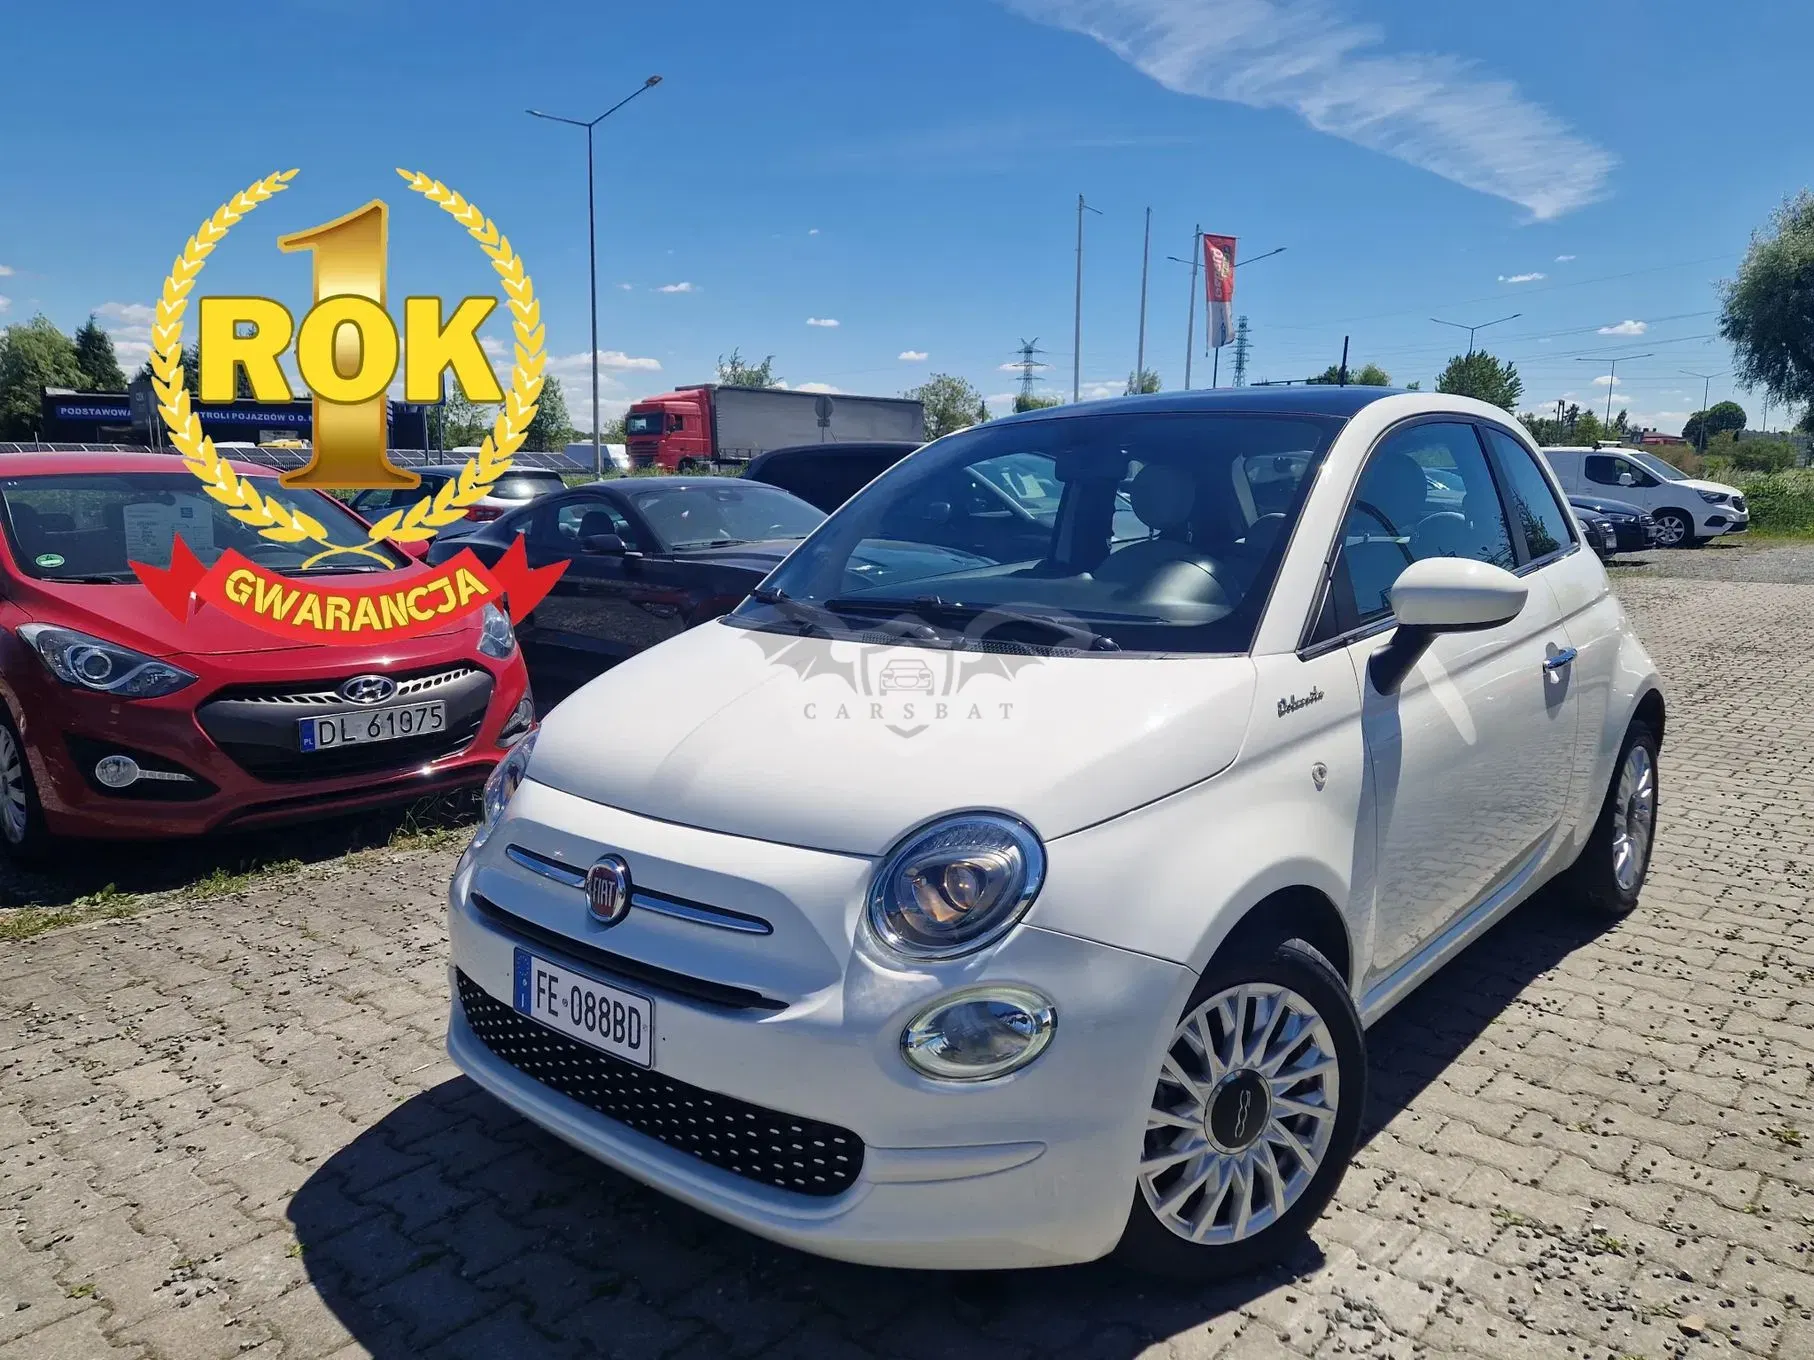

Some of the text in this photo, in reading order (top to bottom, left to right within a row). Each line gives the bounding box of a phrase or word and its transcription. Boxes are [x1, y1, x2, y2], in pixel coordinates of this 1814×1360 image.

[199, 411, 230, 419] TROLI
[319, 705, 442, 746] DL 61075
[592, 877, 616, 907] FIAT
[537, 969, 641, 1050] FE 088BD
